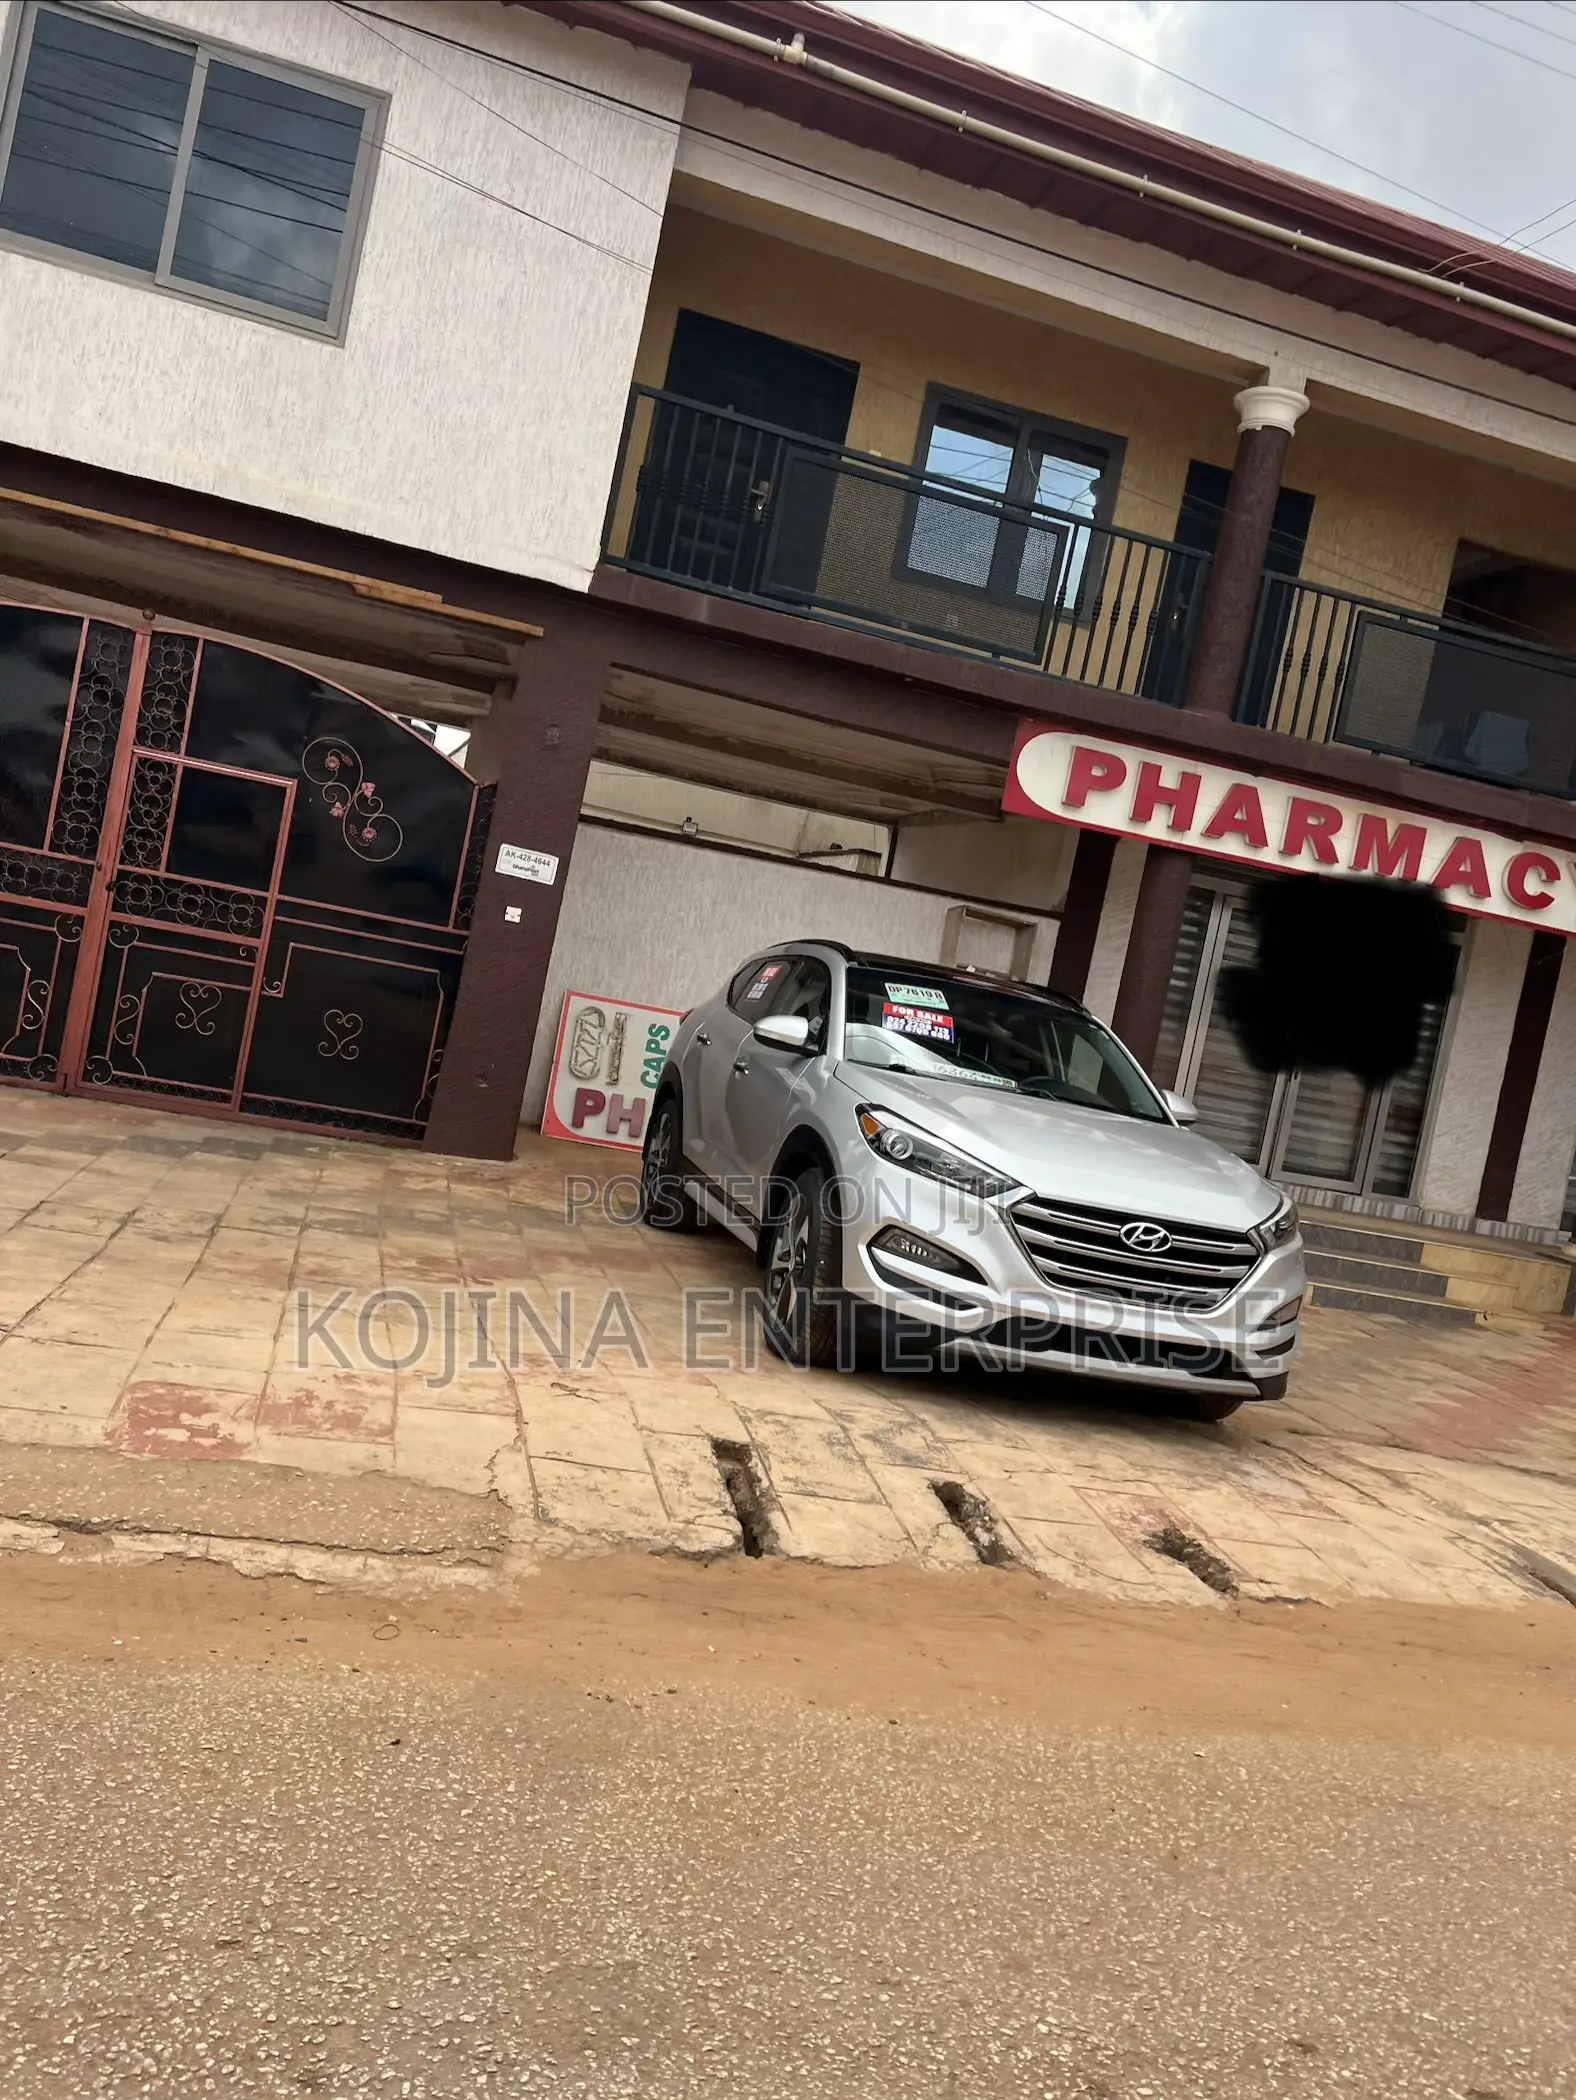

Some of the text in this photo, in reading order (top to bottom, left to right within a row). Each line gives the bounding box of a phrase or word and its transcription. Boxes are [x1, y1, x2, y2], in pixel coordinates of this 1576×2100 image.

[1060, 745, 1576, 911] PHARMAC
[504, 849, 551, 867] AK-428-4644
[887, 985, 902, 994] DP
[892, 1005, 915, 1017] FOR
[916, 1010, 944, 1024] SALE
[640, 1023, 670, 1090] CAPS
